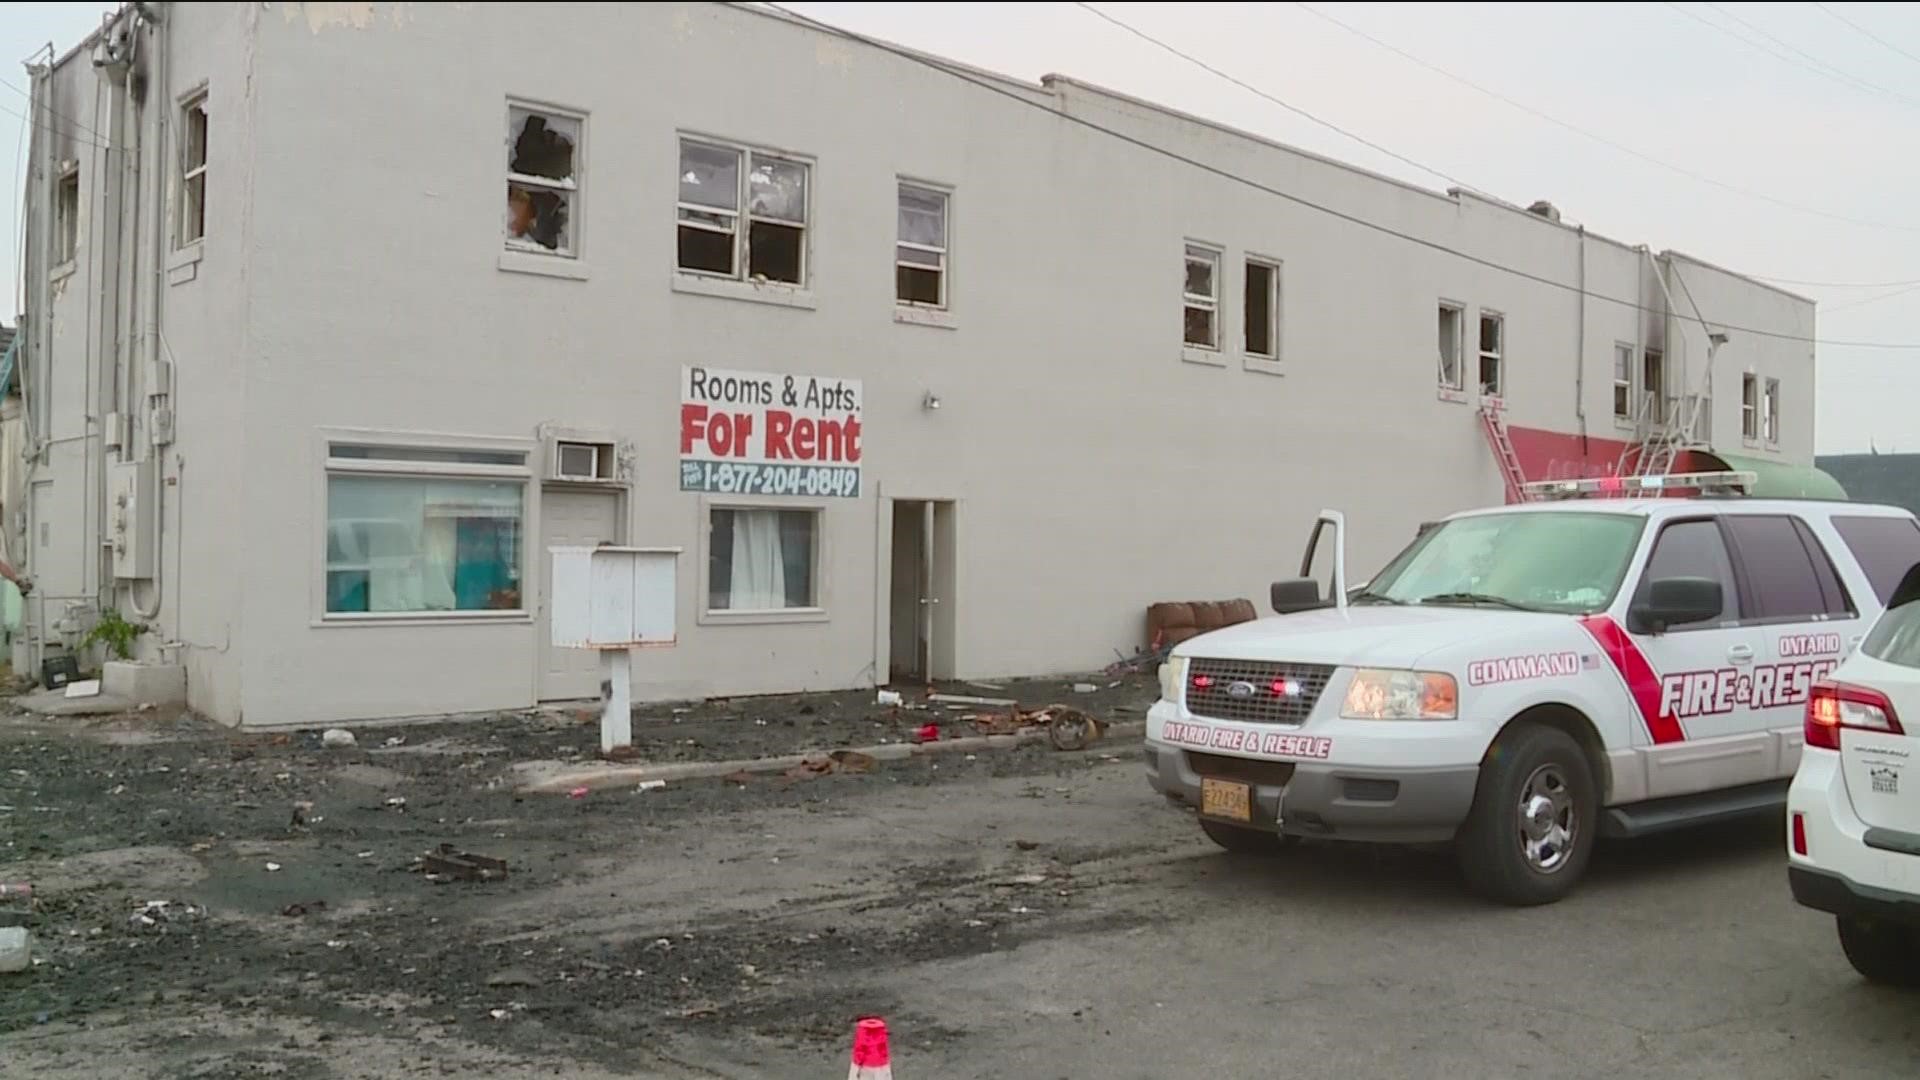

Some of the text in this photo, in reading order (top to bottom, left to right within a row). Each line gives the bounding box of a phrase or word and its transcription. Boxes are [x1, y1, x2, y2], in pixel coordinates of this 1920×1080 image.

[690, 367, 861, 416] Rooms & Apts.
[680, 404, 861, 462] For Rent
[704, 462, 857, 496] 1-877-204-0849
[1779, 633, 1840, 657] ONTARIO
[1468, 652, 1578, 686] COMMAND
[1163, 721, 1332, 759] ONTARIO FIRE & RESCUE
